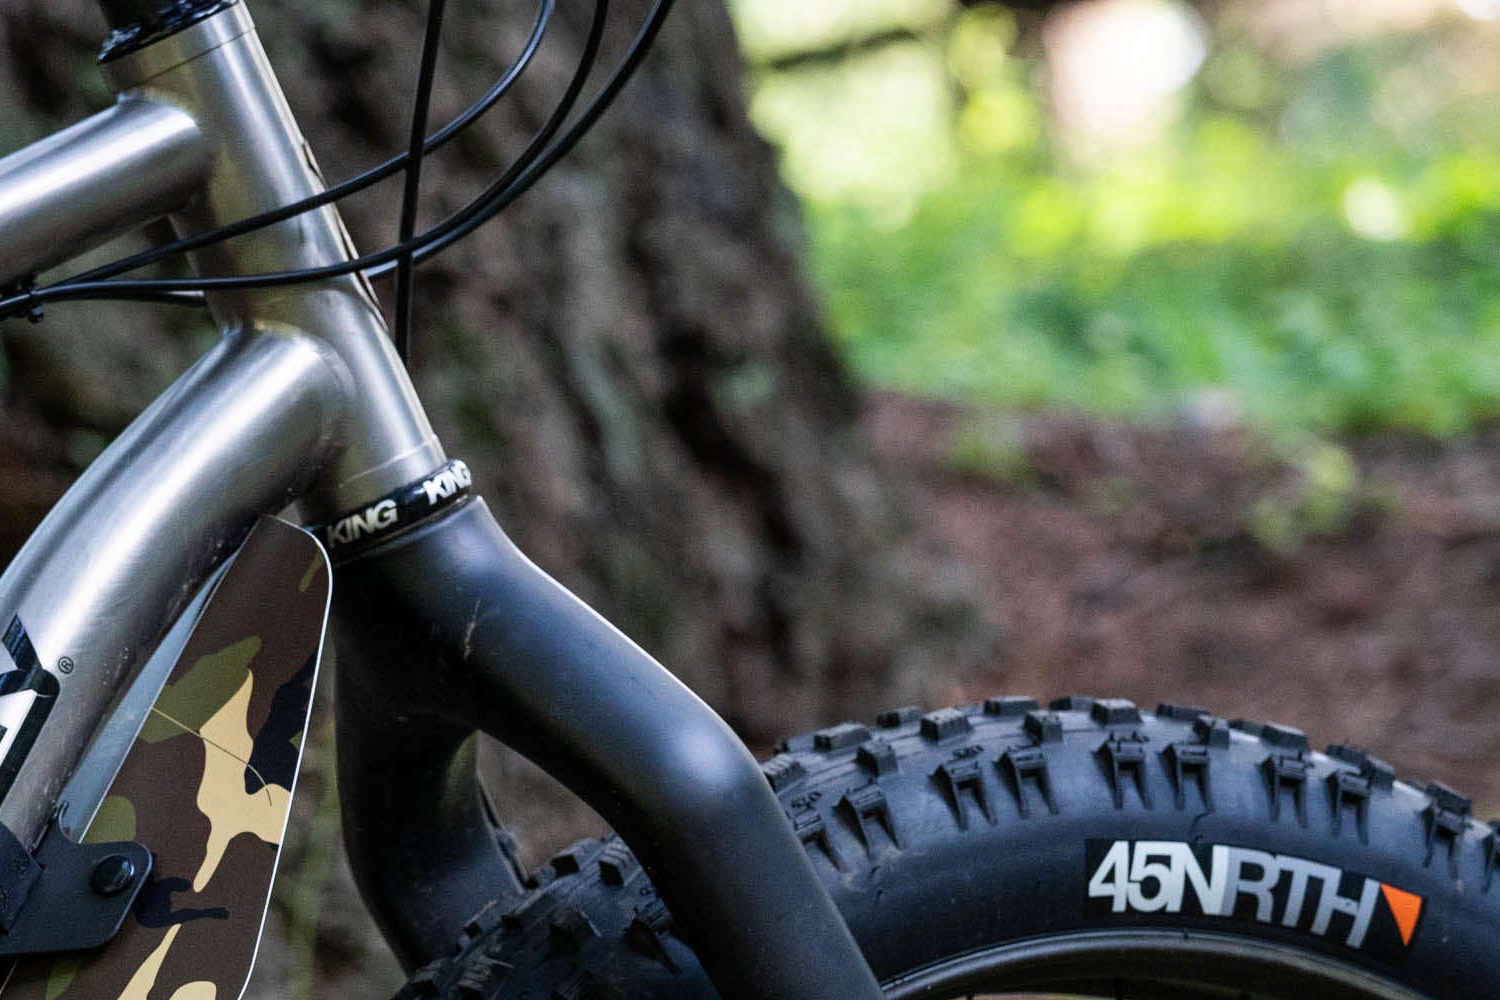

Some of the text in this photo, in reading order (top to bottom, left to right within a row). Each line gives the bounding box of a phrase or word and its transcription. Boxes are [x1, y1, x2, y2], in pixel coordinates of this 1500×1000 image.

[422, 459, 472, 504] KING
[326, 499, 398, 547] KING
[1088, 840, 1381, 949] 45NRTH
